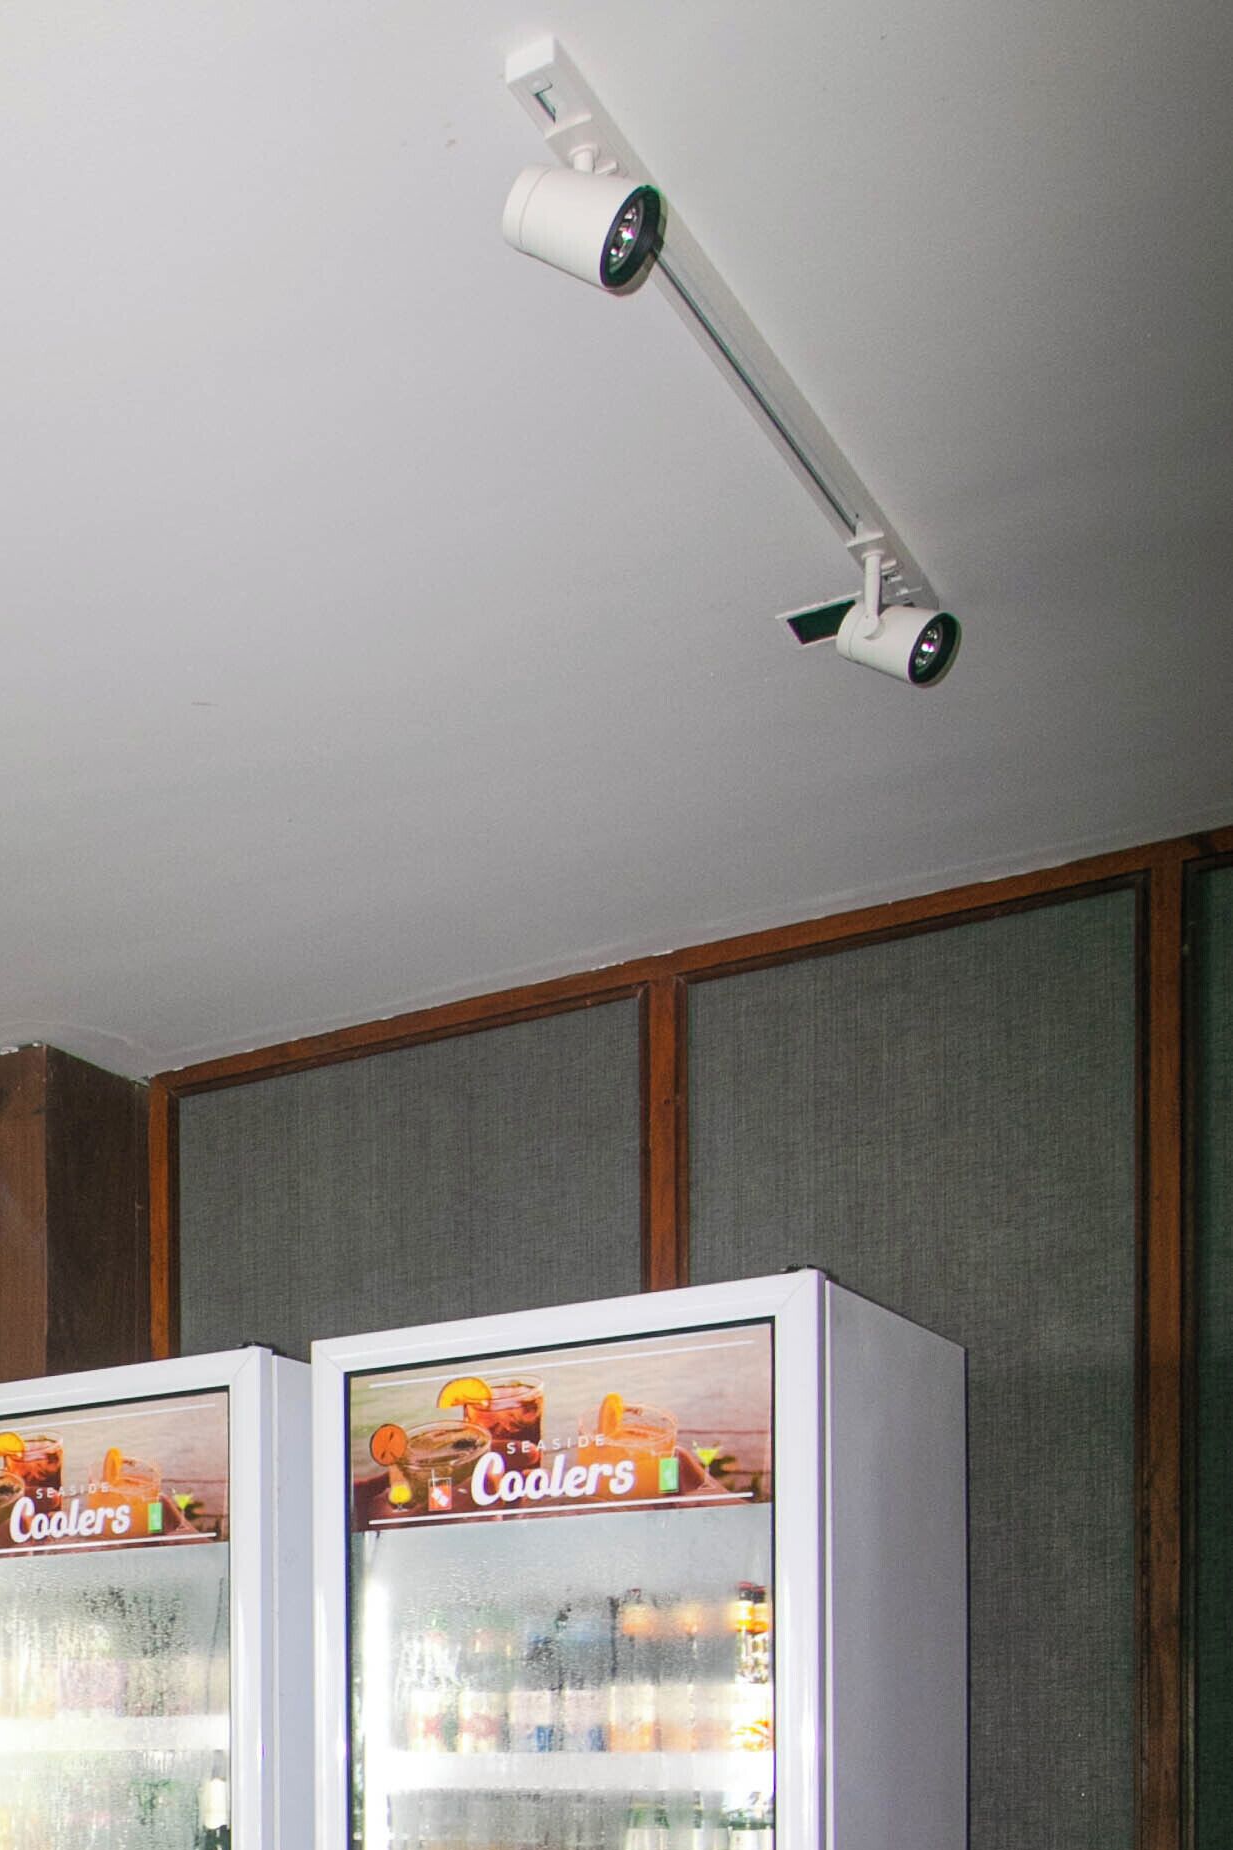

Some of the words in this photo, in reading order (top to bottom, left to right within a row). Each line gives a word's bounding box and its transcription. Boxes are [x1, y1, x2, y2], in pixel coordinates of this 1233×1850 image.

[507, 1434, 605, 1454] SEASIDE
[36, 1482, 111, 1499] SEASIDE
[471, 1451, 635, 1506] Coolers
[10, 1497, 131, 1543] Coolers
